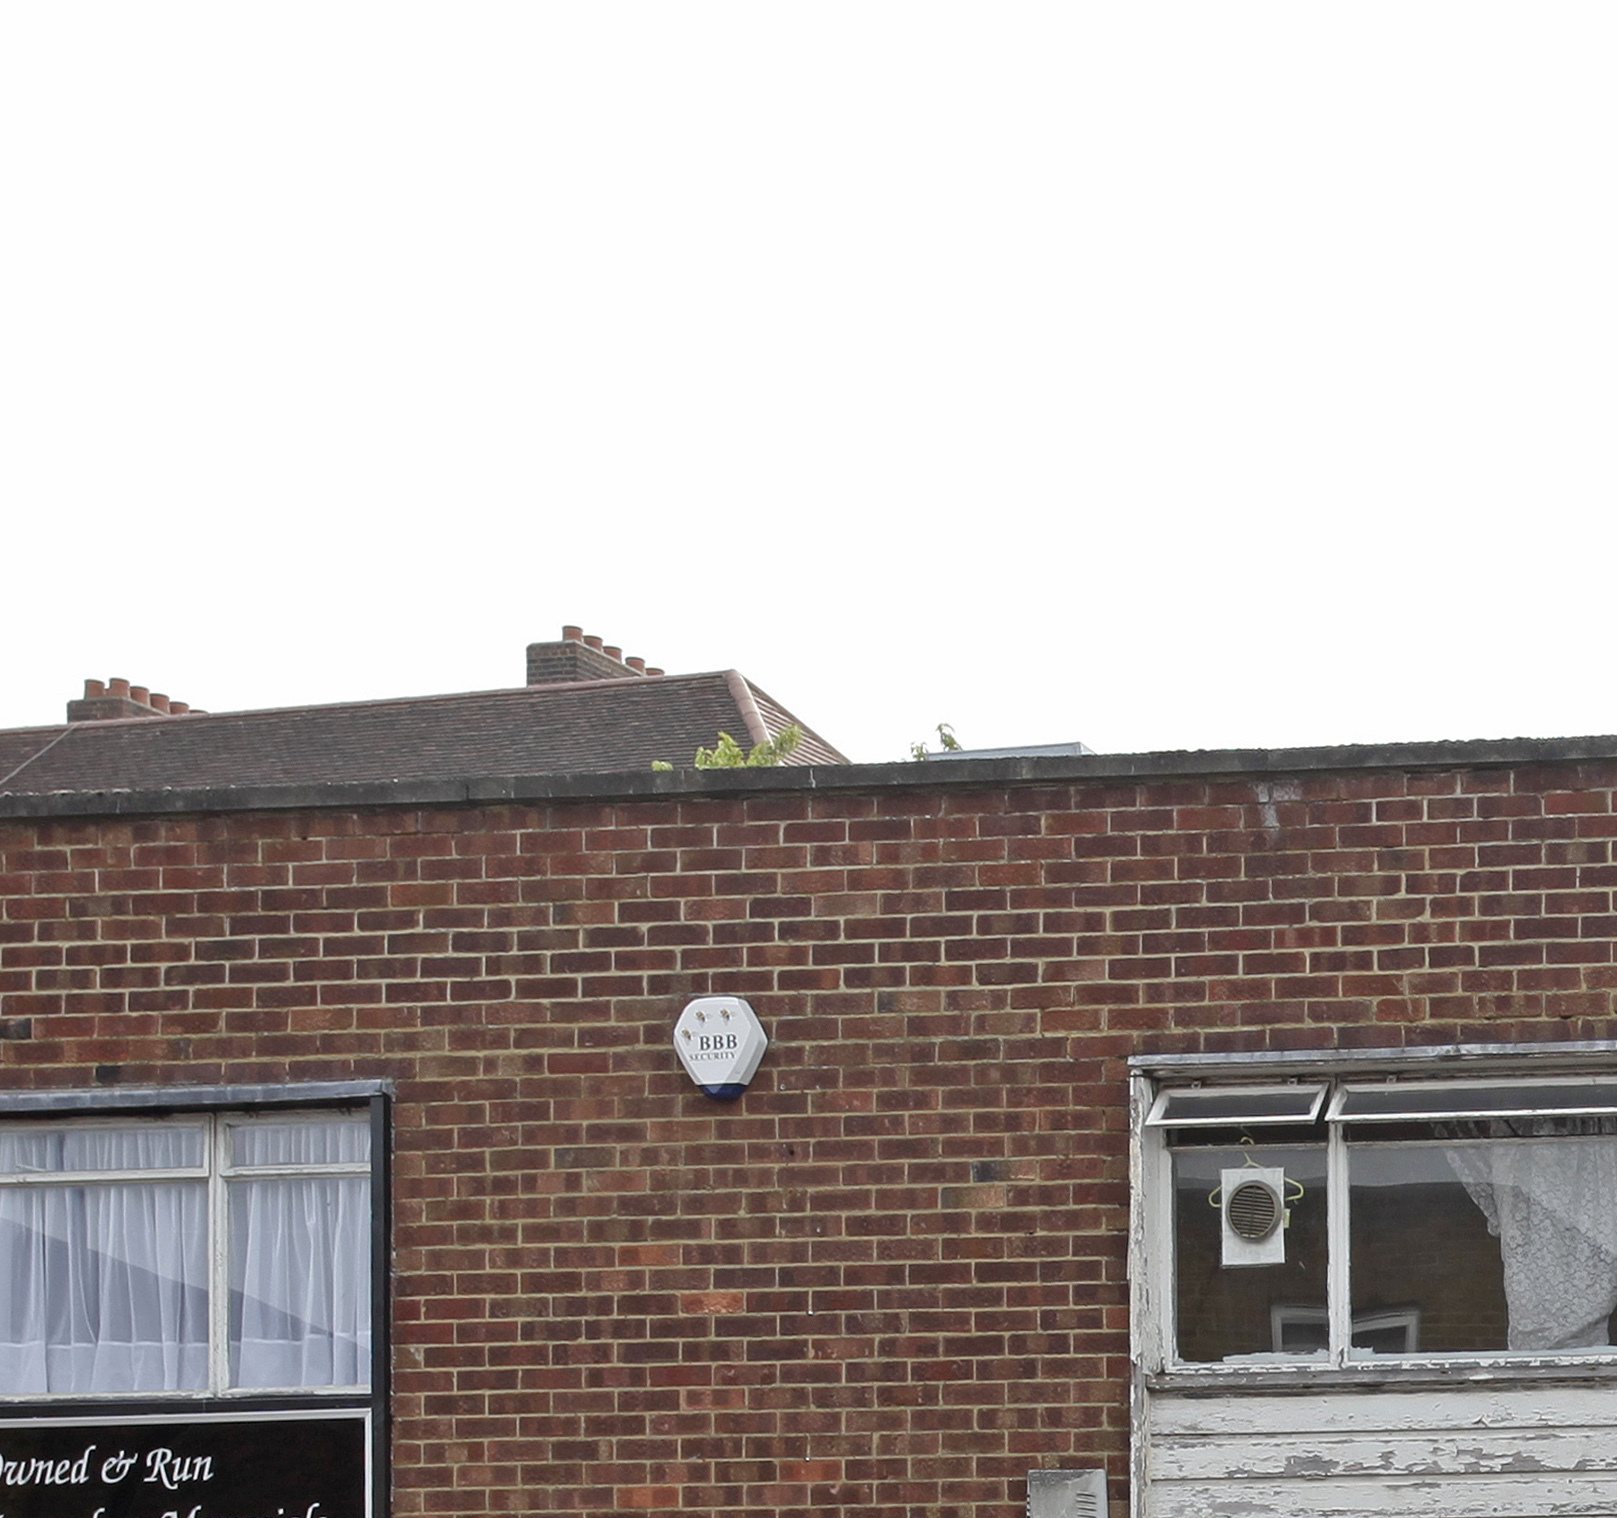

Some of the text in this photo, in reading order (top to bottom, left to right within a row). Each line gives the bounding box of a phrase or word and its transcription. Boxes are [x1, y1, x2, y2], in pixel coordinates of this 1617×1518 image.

[699, 1034, 738, 1051] BBB
[689, 1052, 736, 1061] SECURITY
[0, 1445, 215, 1490] wned & Run
